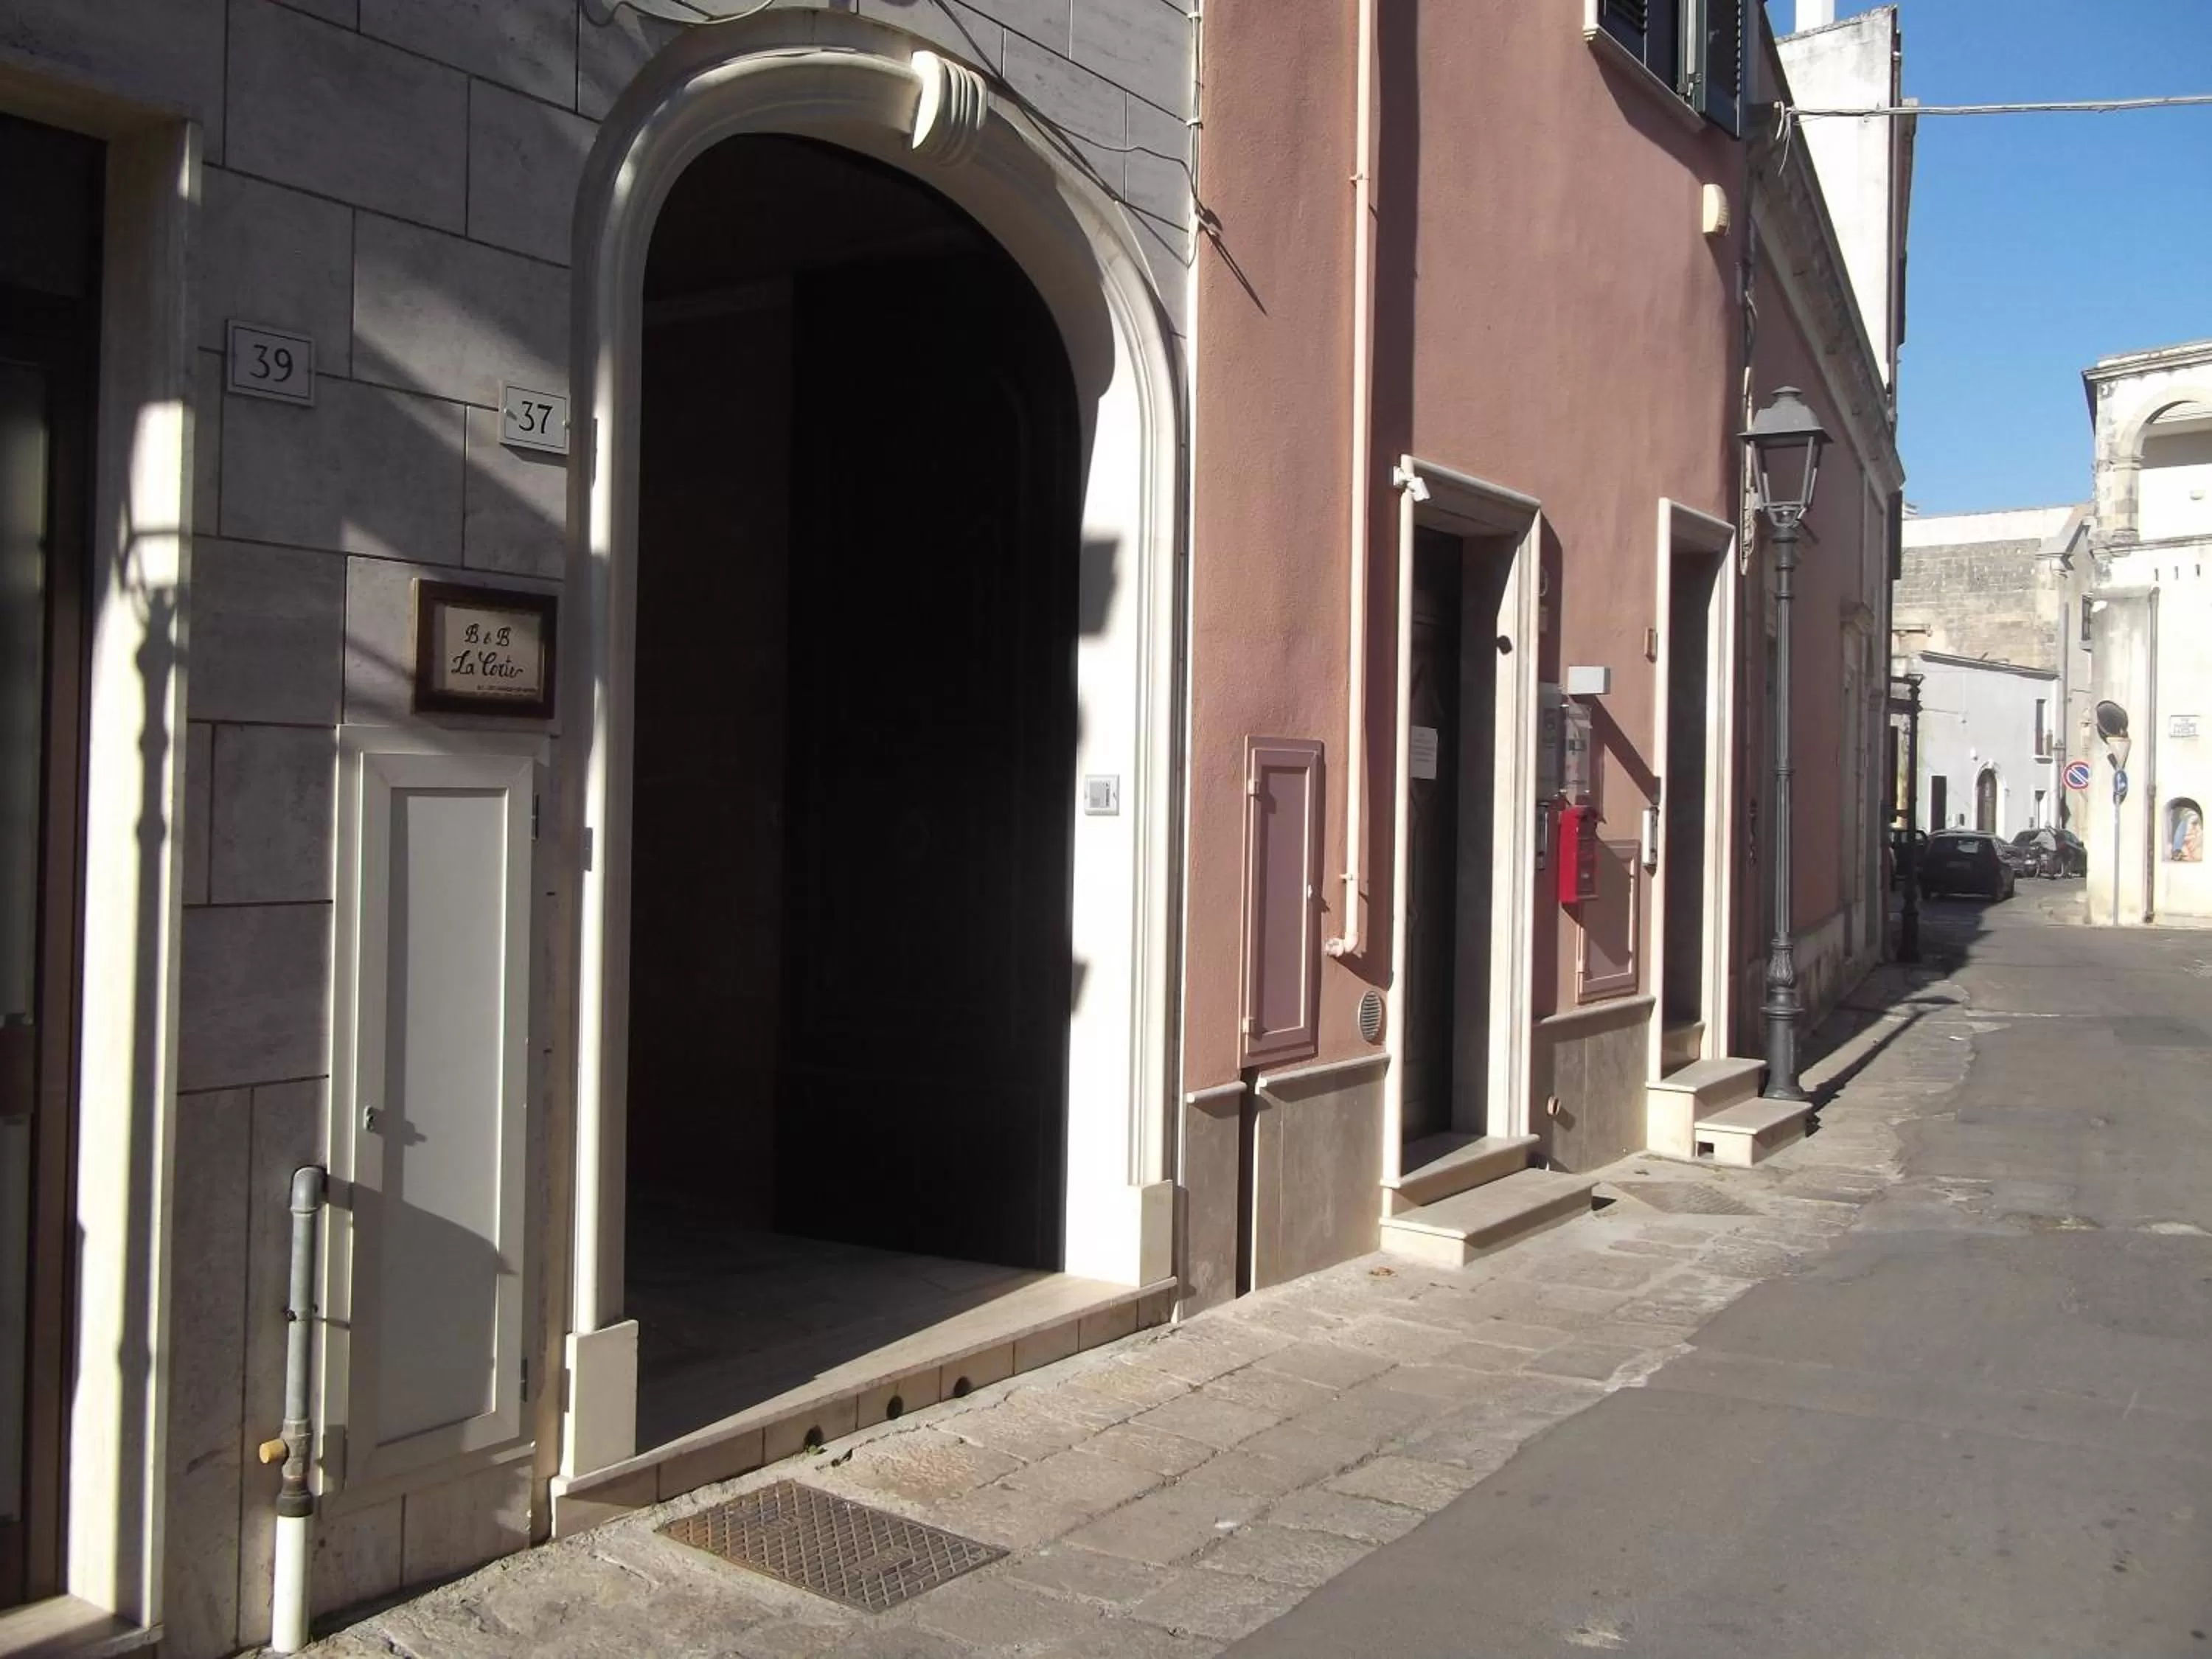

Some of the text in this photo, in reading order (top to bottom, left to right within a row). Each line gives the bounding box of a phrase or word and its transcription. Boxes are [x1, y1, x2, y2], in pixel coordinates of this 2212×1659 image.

[249, 344, 293, 383] 39
[518, 400, 553, 434] 37
[464, 623, 479, 644] B
[495, 626, 512, 647] B
[451, 650, 474, 675] La
